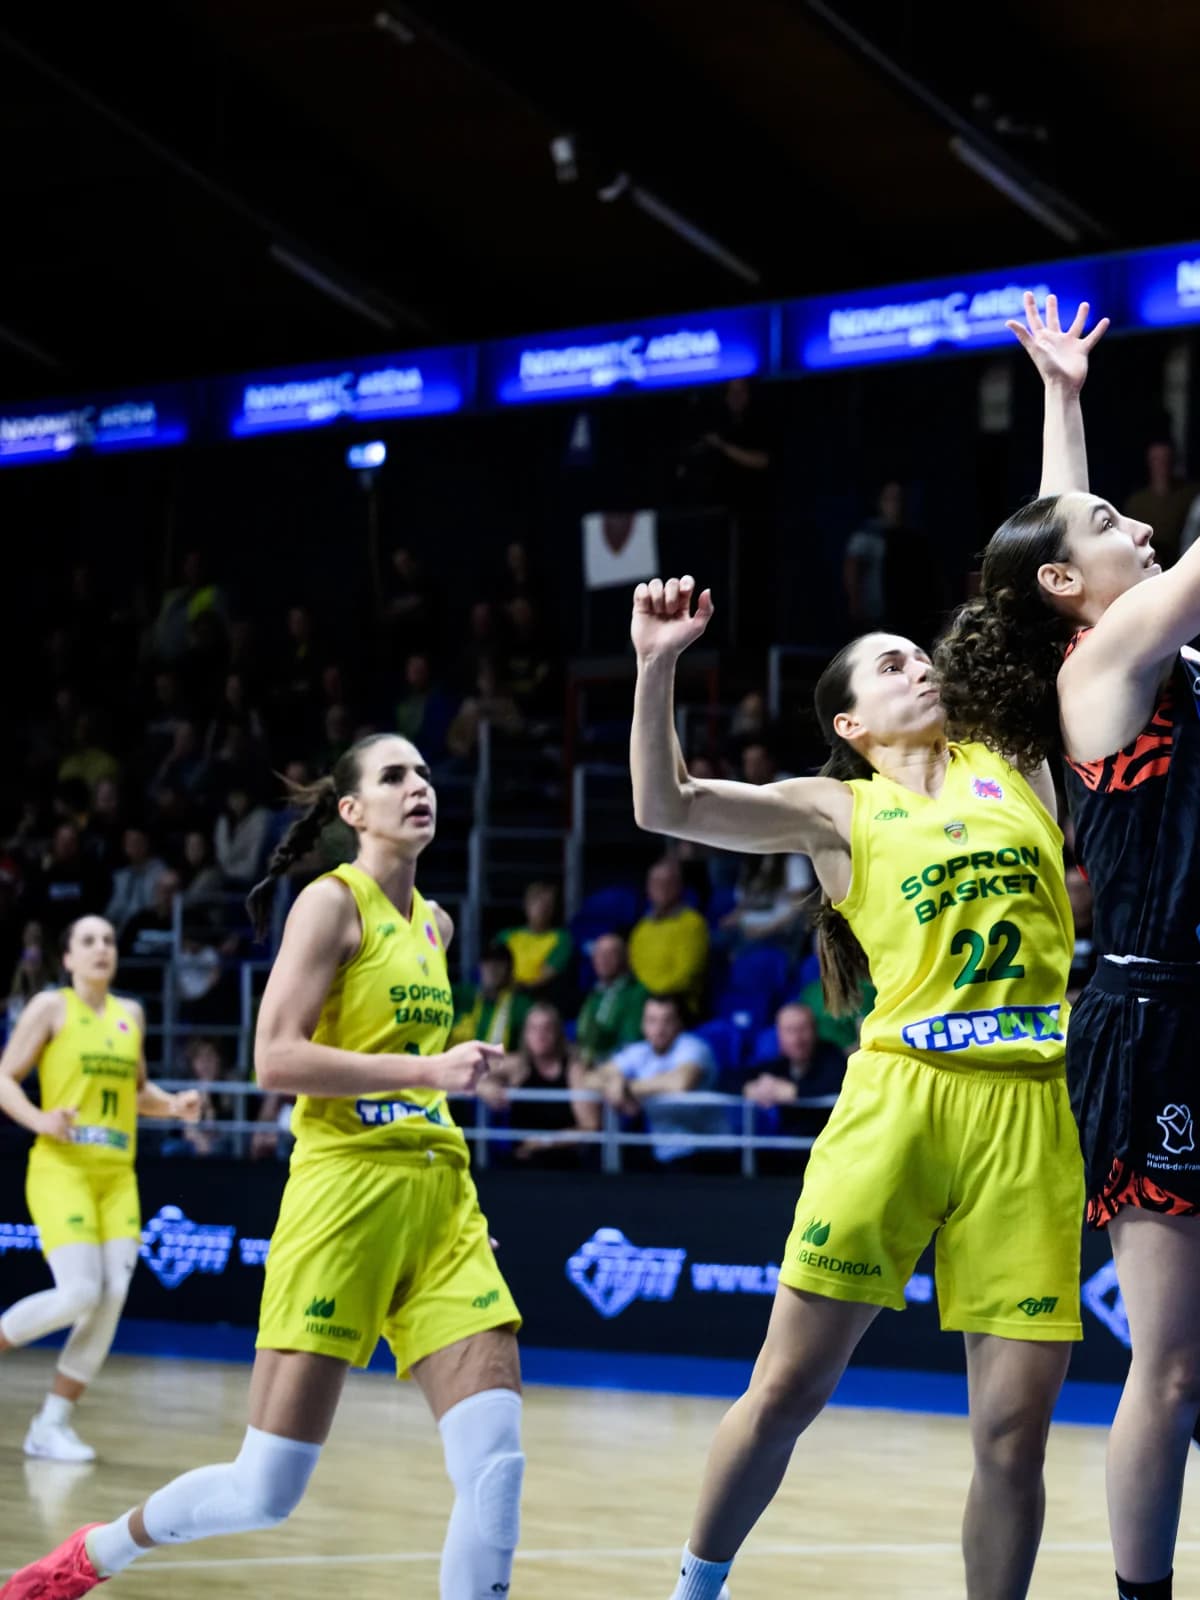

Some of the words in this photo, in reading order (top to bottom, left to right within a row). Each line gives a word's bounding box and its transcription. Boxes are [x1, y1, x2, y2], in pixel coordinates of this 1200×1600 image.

[901, 845, 1040, 901] SOPRON
[914, 873, 1039, 926] BASKET
[950, 919, 1026, 991] 22
[797, 1250, 883, 1278] IBERDROLA
